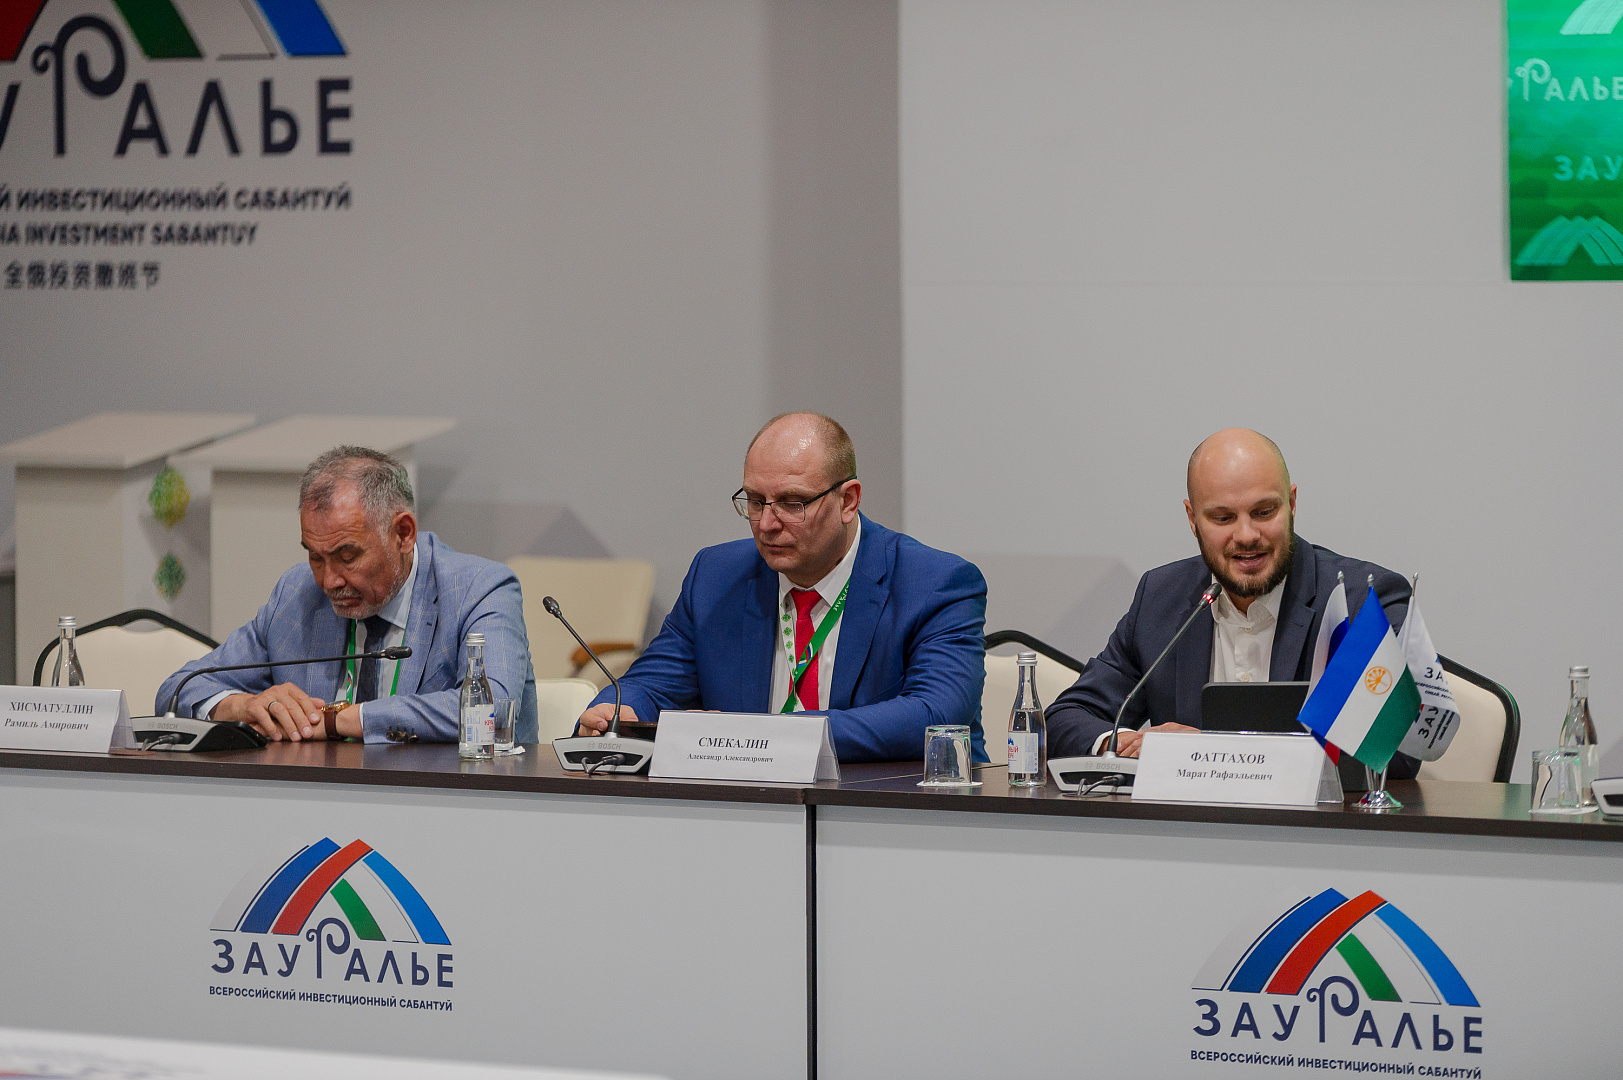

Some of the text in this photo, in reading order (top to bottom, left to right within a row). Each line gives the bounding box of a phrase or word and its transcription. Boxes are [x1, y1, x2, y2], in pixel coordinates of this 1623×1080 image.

[1508, 58, 1623, 101] РАЛЬЕ
[1554, 154, 1623, 181] ЗАУ
[17, 182, 226, 214] ИНВЕСТИЦИОННЫЙ
[233, 182, 352, 211] САБАНТУЙ
[25, 222, 146, 246] INVESTMENT
[151, 222, 258, 246] SABANTUY
[9, 701, 94, 715] ХИСМАТУЛЛИН
[4, 717, 89, 731] Рамиль Амирович
[598, 742, 622, 750] BOSCH
[698, 736, 769, 750] СМЕКАЛИН
[687, 753, 774, 764] Александр Александрович
[1096, 762, 1121, 770] BOSCH
[1190, 752, 1266, 765] ФАТТАХОВ
[1176, 768, 1273, 781] Марат Рафаэльевич
[210, 918, 454, 988] ЗАУРАЛЬЕ
[209, 985, 453, 1012] ВСЕРОССИЙСКИЙ ИНВЕСТИЦИОННЫЙ САБАНТУЙ
[1192, 975, 1483, 1054] ЗАУРАЛЬЕ
[1190, 1050, 1482, 1080] ВСЕРОССИЙСКИЙ ИНВЕСТИЦИОННЫЙ САБАНТУЙ
